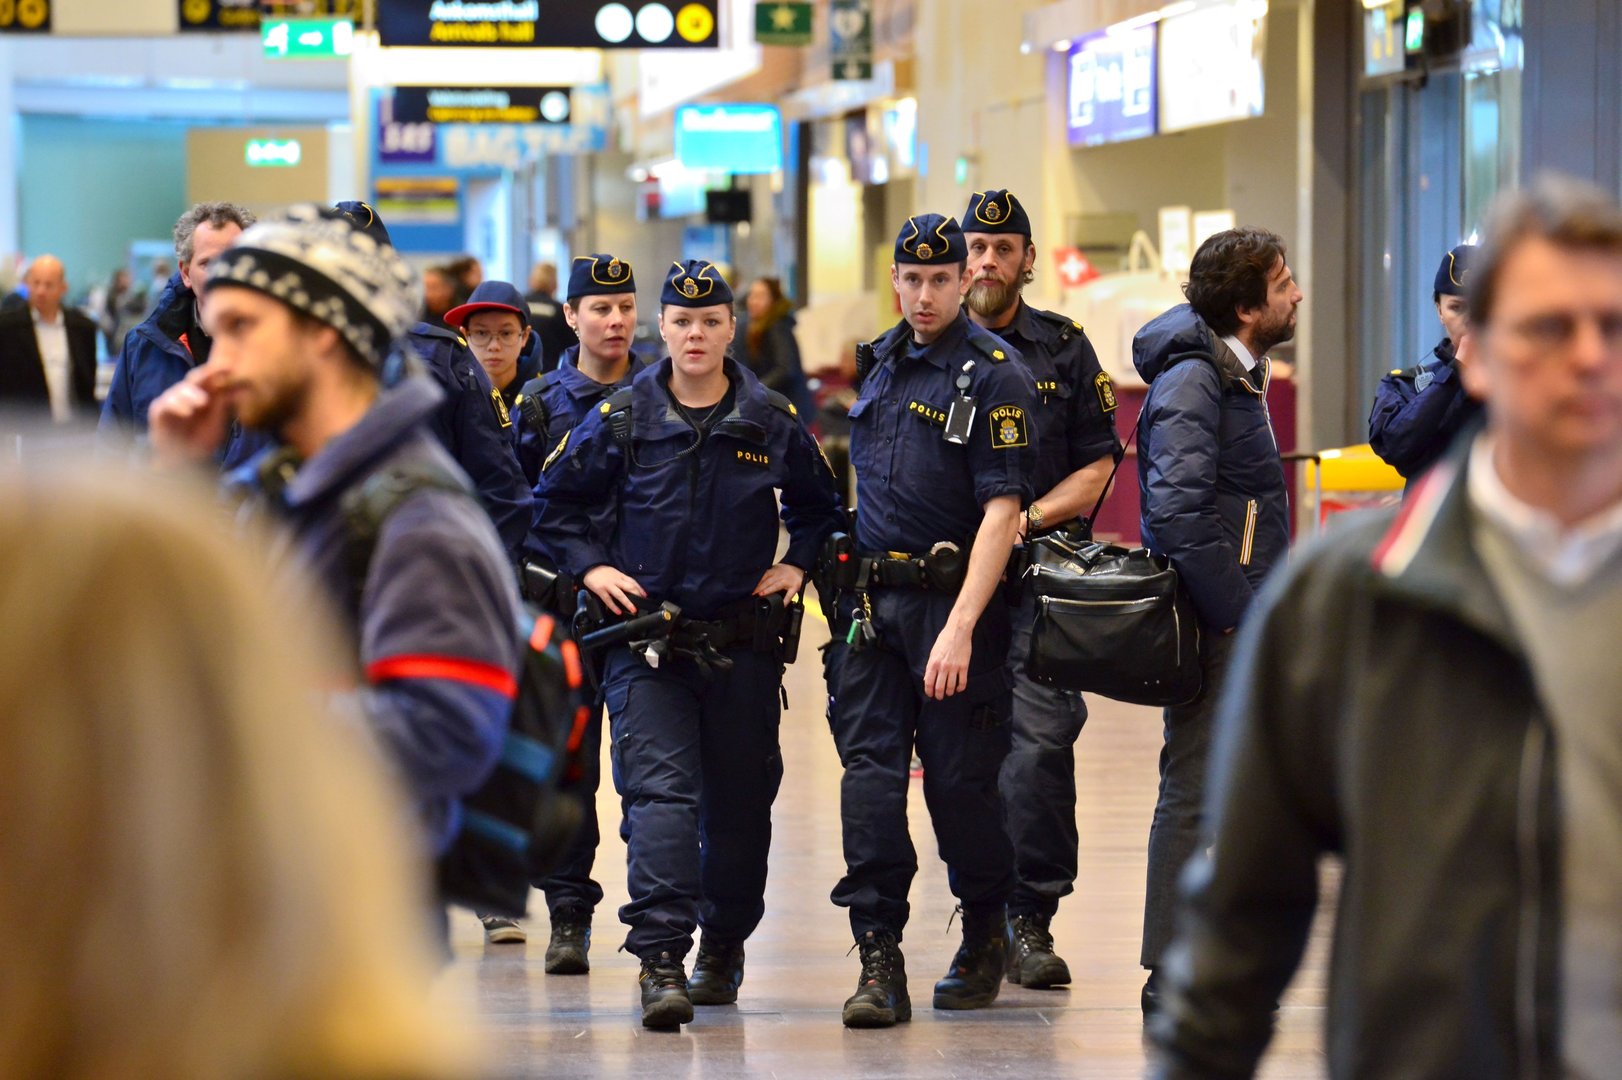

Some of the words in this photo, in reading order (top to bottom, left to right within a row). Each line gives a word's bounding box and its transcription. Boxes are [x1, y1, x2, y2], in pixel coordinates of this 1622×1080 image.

[1037, 381, 1056, 389] LIS
[910, 401, 946, 421] POLIS
[992, 408, 1022, 421] POLIS
[737, 451, 769, 464] POLIS
